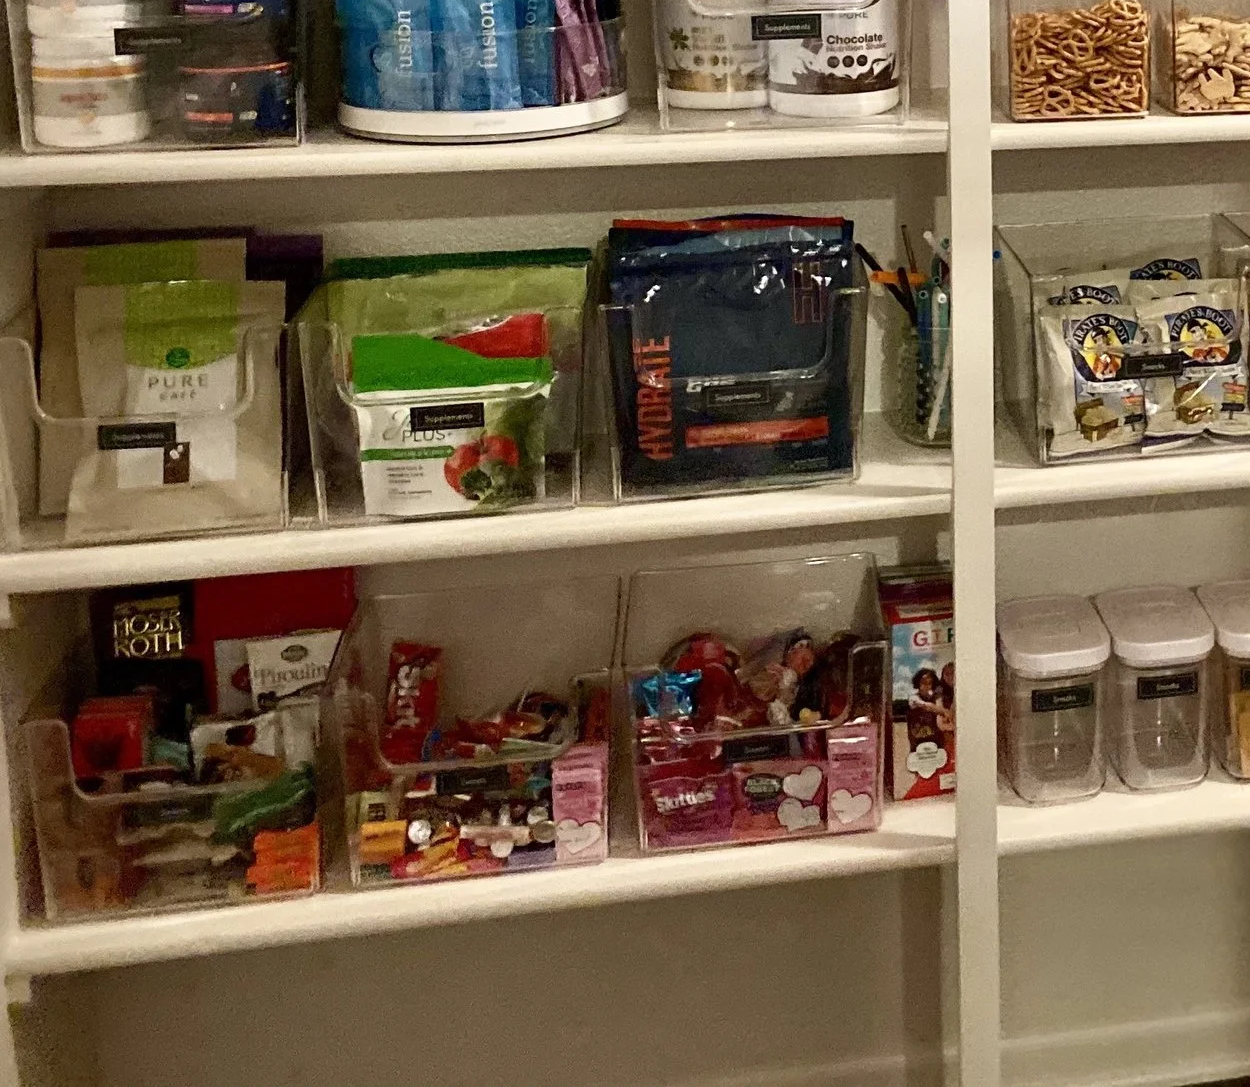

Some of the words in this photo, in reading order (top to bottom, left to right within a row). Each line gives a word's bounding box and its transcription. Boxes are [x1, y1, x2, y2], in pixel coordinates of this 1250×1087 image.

[478, 0, 498, 70] fusion
[763, 22, 812, 33] Supplements
[825, 32, 884, 46] Chocolate
[826, 44, 864, 54] Nutrition
[864, 41, 888, 51] Shake
[147, 373, 209, 390] PURE
[632, 335, 674, 460] HYDRATE
[423, 413, 474, 424] Supplements
[402, 429, 446, 443] PLUS
[113, 610, 182, 638] MOSER
[114, 630, 185, 659] ROTH
[654, 781, 717, 814] Skittles
